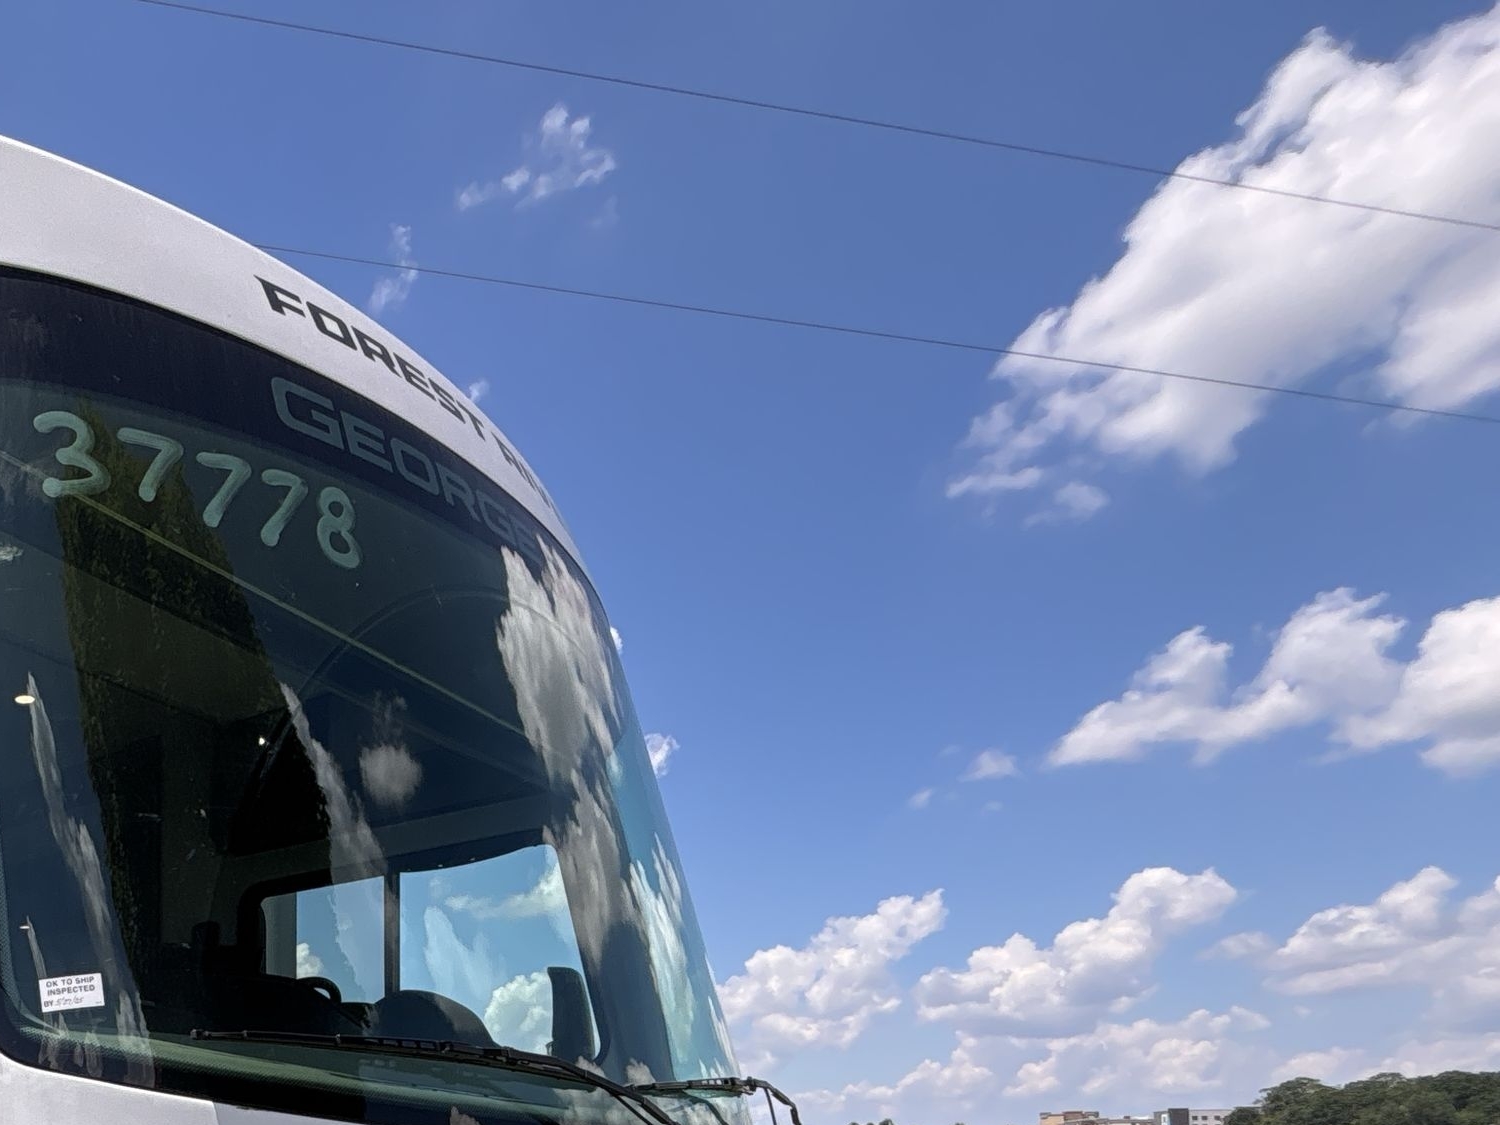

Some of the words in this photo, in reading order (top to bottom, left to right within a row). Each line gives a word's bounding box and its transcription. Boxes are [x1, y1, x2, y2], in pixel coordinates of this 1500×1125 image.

[254, 275, 484, 441] FOREST
[33, 410, 362, 569] 37778
[46, 980, 58, 988] OK
[61, 978, 73, 986] TO
[75, 975, 95, 985] SHIP
[47, 984, 95, 996] INSPECTED
